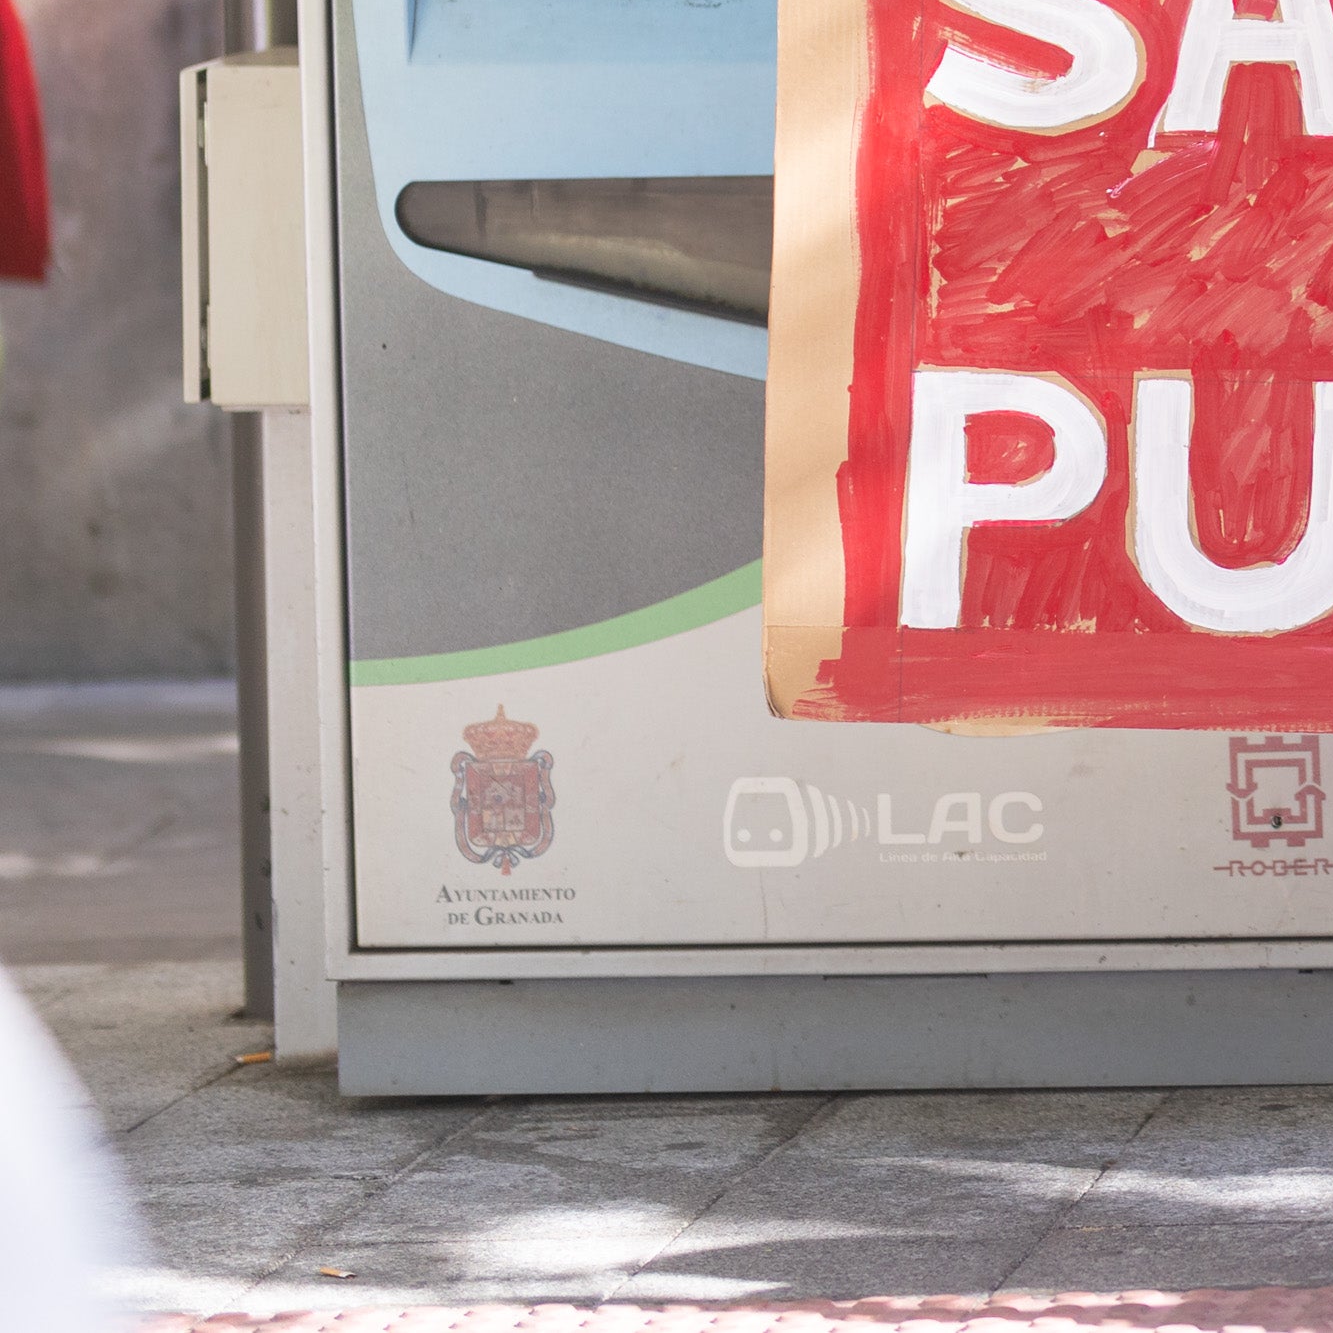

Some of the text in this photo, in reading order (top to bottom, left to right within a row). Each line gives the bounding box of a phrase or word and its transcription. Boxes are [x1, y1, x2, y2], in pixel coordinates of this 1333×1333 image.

[877, 791, 1044, 844] LAC
[921, 852, 938, 862] de
[974, 851, 1047, 864] Capacidad
[436, 884, 576, 903] AYUNTAMIENTO
[448, 906, 563, 926] DE GRANADA
